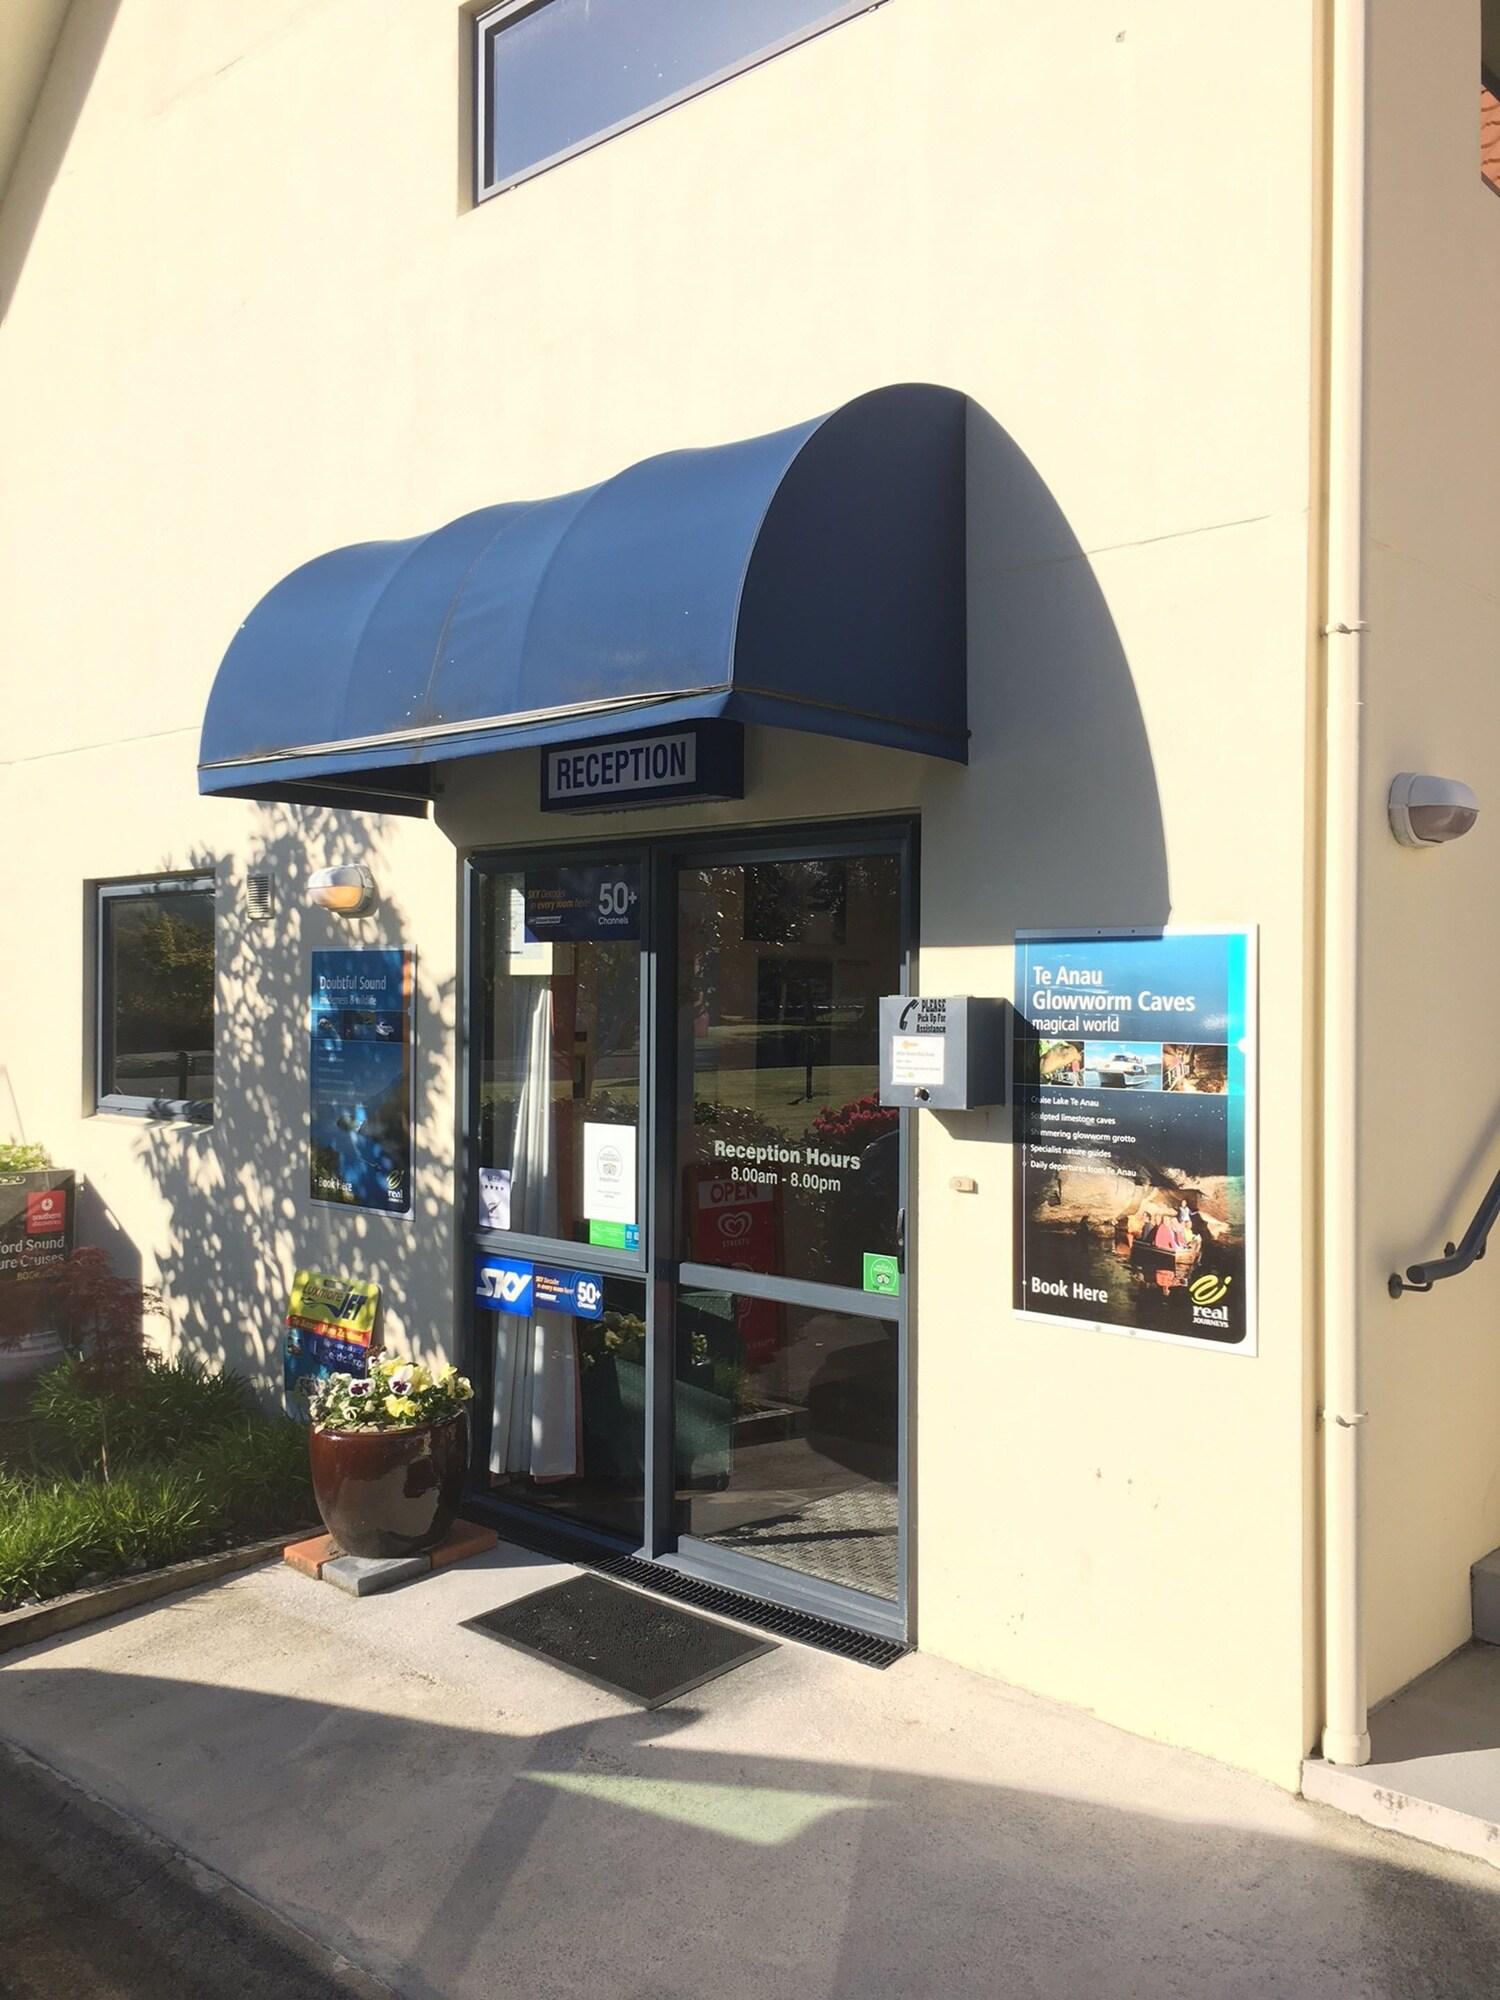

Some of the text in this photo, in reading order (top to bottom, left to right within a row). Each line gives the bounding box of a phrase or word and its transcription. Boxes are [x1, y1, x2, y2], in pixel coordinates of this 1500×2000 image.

[557, 741, 686, 791] RECEPTION
[598, 881, 638, 916] 50+
[598, 916, 629, 926] Channels
[320, 975, 387, 990] Doubtful Sound
[1032, 965, 1103, 986] Te Anau
[921, 998, 946, 1012] PLEASE
[1032, 990, 1196, 1012] Glowworm Caves
[917, 1013, 929, 1023] Pick
[937, 1013, 946, 1023] For
[1032, 1016, 1120, 1035] magical world
[916, 1024, 946, 1034] Assistance
[1053, 1096, 1068, 1105] Lake
[1070, 1097, 1079, 1106] Te
[1080, 1098, 1099, 1107] Anau
[1031, 1112, 1116, 1125] Sculpted limestone caves
[1073, 1131, 1111, 1142] glowworm
[1112, 1135, 1136, 1144] grotto
[714, 1139, 861, 1170] Reception Hours
[1030, 1144, 1111, 1158] Specialist nature guides
[1031, 1160, 1048, 1171] Daily
[1049, 1162, 1088, 1173] departures
[1107, 1166, 1116, 1175] Te
[1116, 1168, 1137, 1177] Anau
[731, 1166, 778, 1185] 8.00am
[790, 1172, 841, 1193] 8.00pm
[710, 1182, 758, 1203] OPEN
[26, 1235, 65, 1252] Sound
[476, 1267, 533, 1302] SKY
[577, 1281, 601, 1305] 50+
[1031, 1276, 1109, 1303] Book Here
[1192, 1305, 1229, 1321] real
[1192, 1317, 1230, 1328] JOURNEYS
